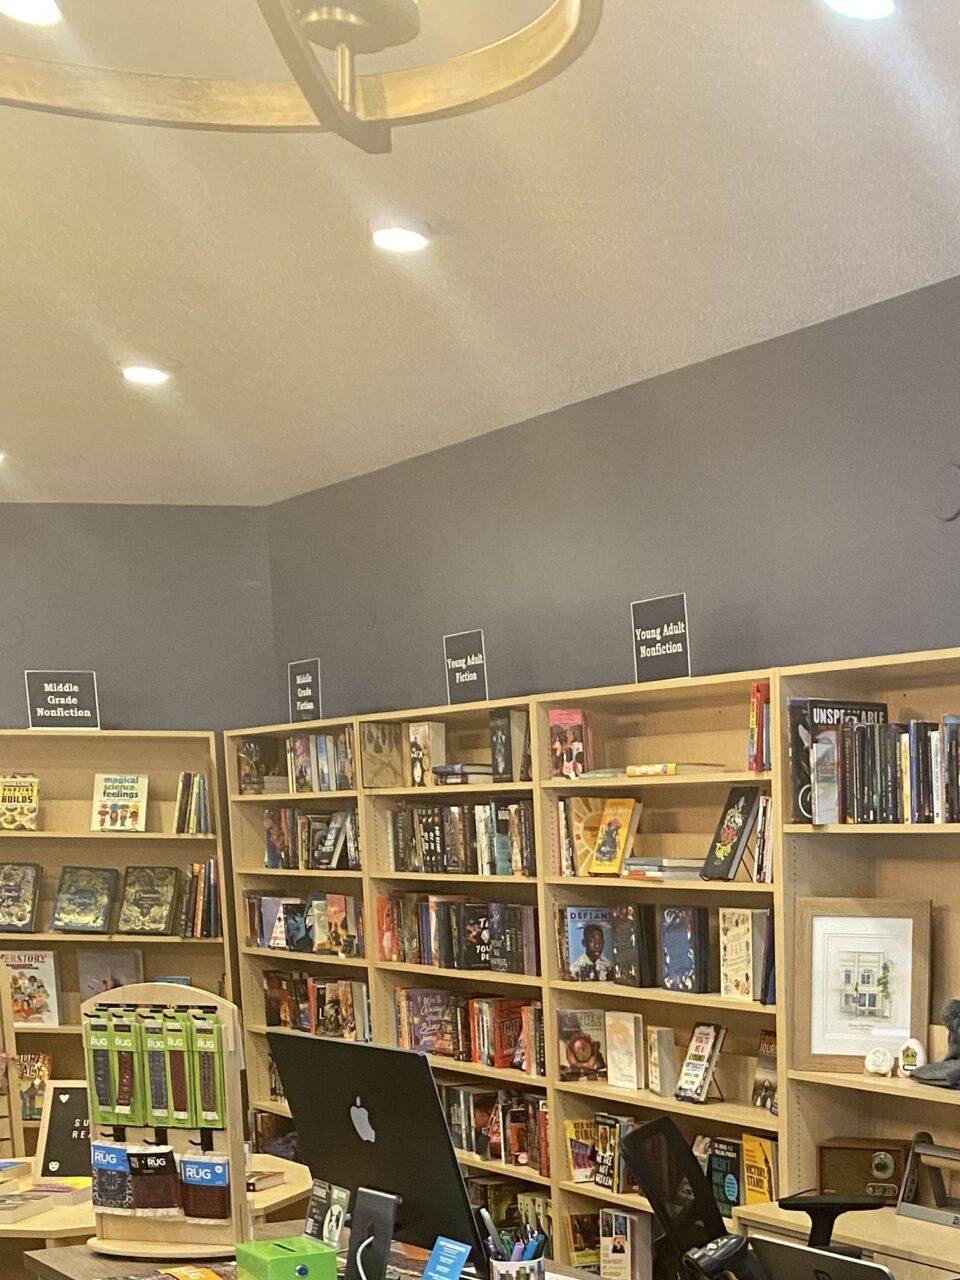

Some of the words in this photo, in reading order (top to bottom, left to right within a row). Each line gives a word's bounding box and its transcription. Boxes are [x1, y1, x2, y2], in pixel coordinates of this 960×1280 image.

[635, 628, 661, 641] Young
[662, 621, 685, 636] Adult
[640, 642, 683, 658] Nonfiction
[447, 657, 466, 669] Young
[466, 653, 484, 666] Adult
[455, 671, 478, 684] Fiction
[44, 683, 79, 692] Middle
[47, 695, 78, 704] Grade
[36, 708, 92, 717] Nonfiction
[104, 776, 139, 785] magical
[104, 784, 135, 792] science
[103, 790, 139, 799] feelings
[90, 1038, 107, 1046] RUG
[115, 1039, 131, 1047] RUG
[148, 1040, 164, 1048] RUG
[167, 1038, 183, 1047] RUG
[197, 1040, 214, 1048] RUG
[94, 1152, 117, 1164] RUG
[147, 1157, 166, 1167] RUG
[185, 1167, 211, 1179] RUG
